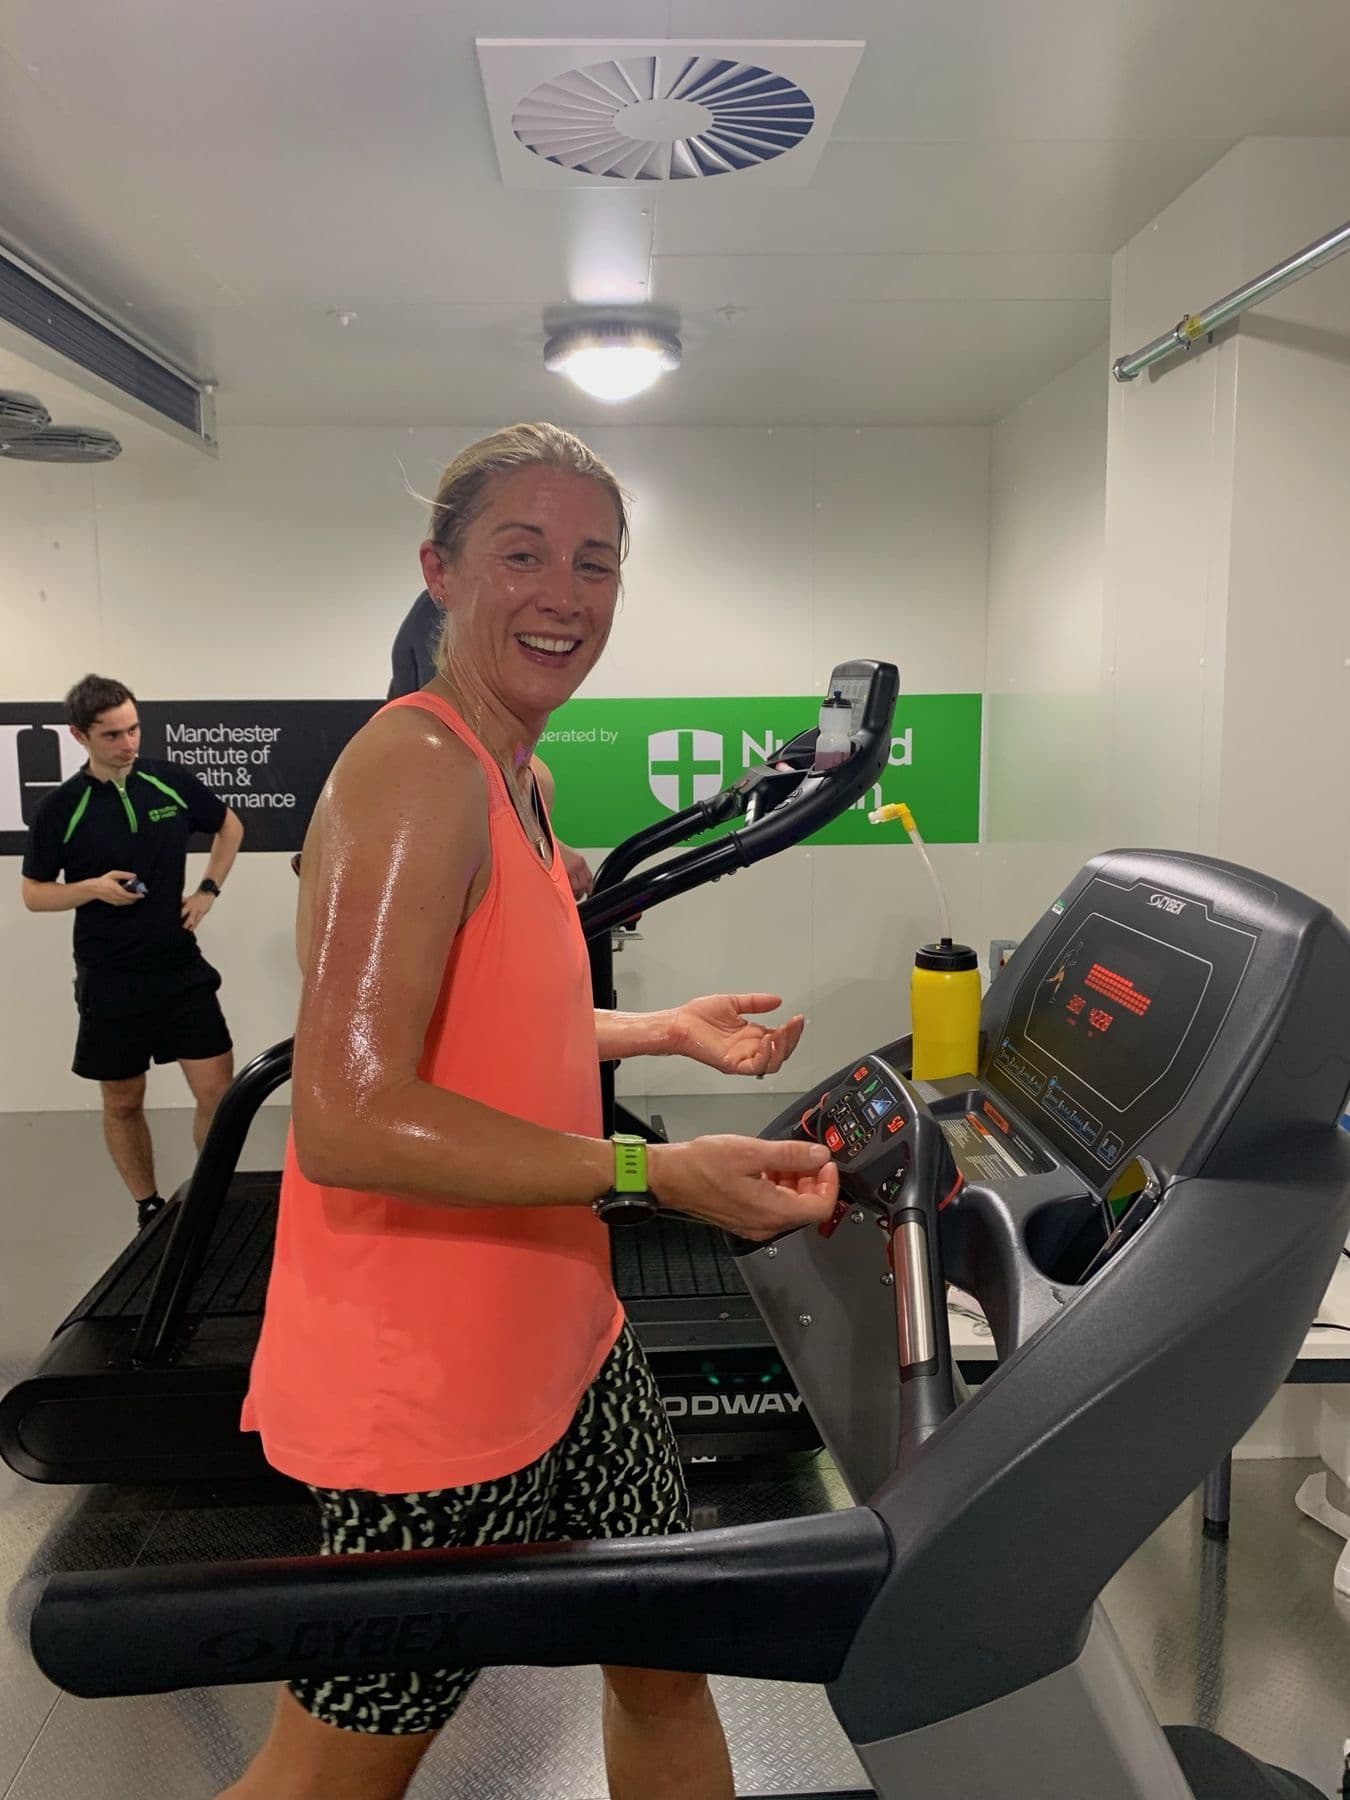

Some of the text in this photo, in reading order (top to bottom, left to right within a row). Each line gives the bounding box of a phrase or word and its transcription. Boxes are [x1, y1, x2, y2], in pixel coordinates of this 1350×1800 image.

[165, 723, 281, 743] Manchester
[537, 728, 618, 746] perated by
[167, 745, 271, 765] Institute of
[196, 766, 252, 787] alth &
[1158, 895, 1187, 915] CYBEX
[662, 1393, 803, 1417] ODWAY
[287, 1610, 474, 1661] CYBEX
